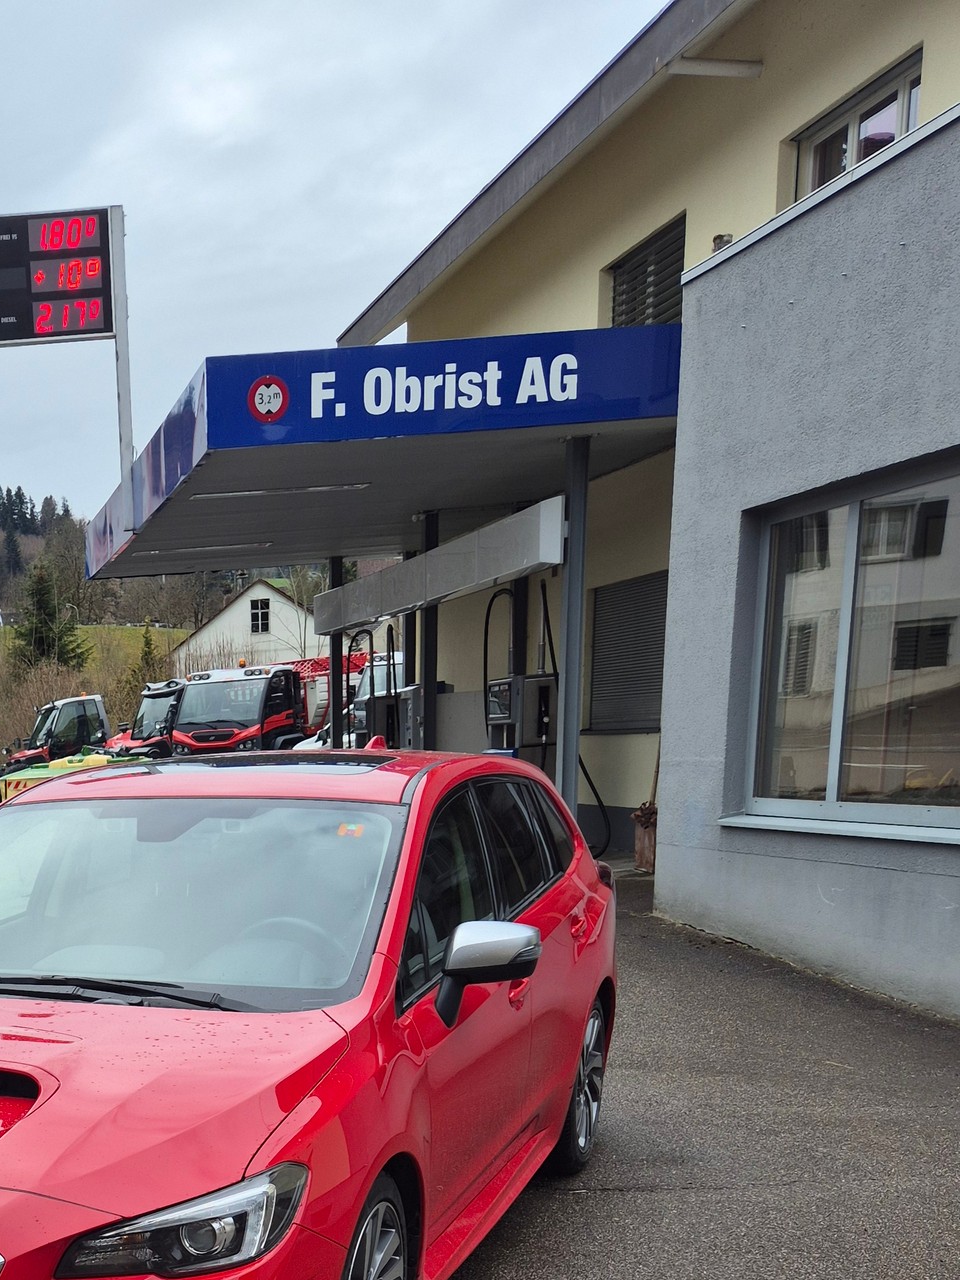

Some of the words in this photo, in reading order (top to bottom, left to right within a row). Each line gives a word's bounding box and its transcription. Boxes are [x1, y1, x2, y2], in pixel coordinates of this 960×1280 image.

[311, 371, 346, 418] F.
[363, 361, 502, 415] Obrist
[515, 353, 578, 404] AG
